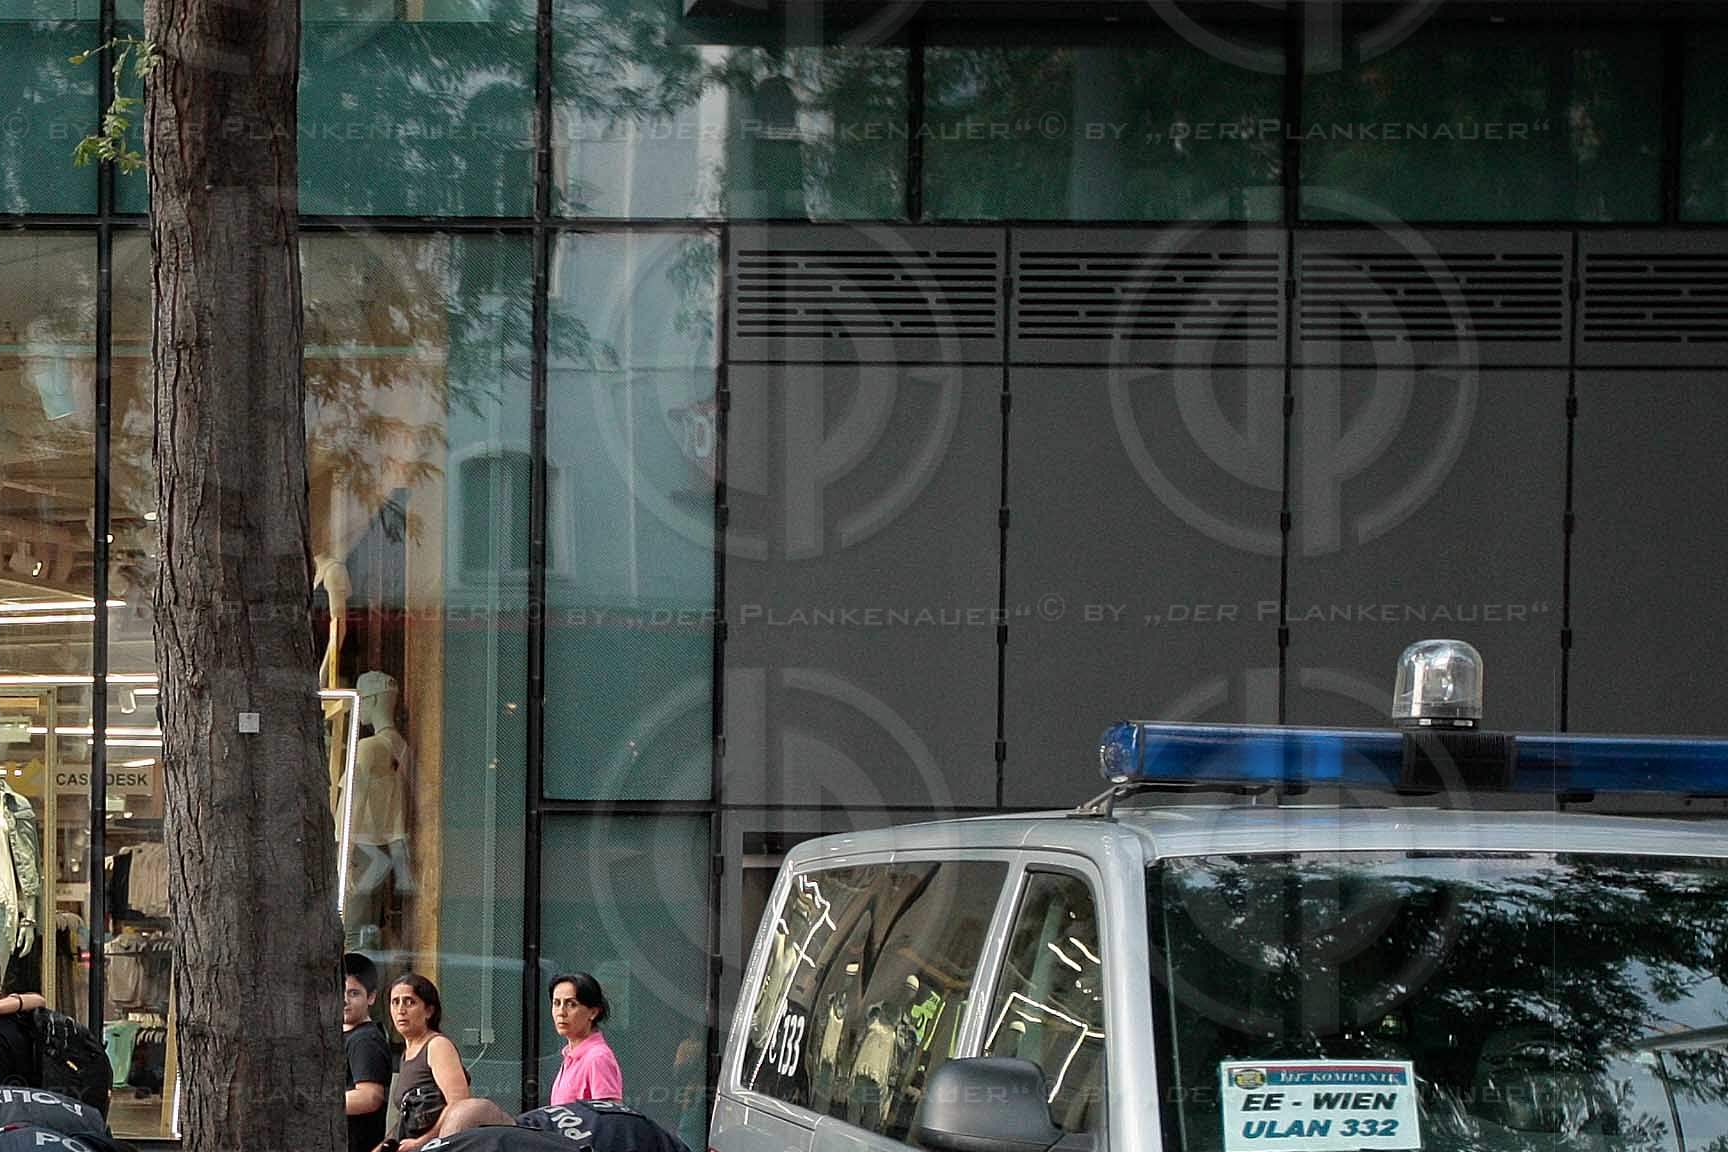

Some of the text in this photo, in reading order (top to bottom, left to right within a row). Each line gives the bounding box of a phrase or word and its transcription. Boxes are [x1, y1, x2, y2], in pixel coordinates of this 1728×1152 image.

[56, 773, 92, 787] CAS
[1240, 1094, 1286, 1111] EE
[1312, 1093, 1397, 1110] WIEN
[1242, 1119, 1399, 1138] ULAN 332
